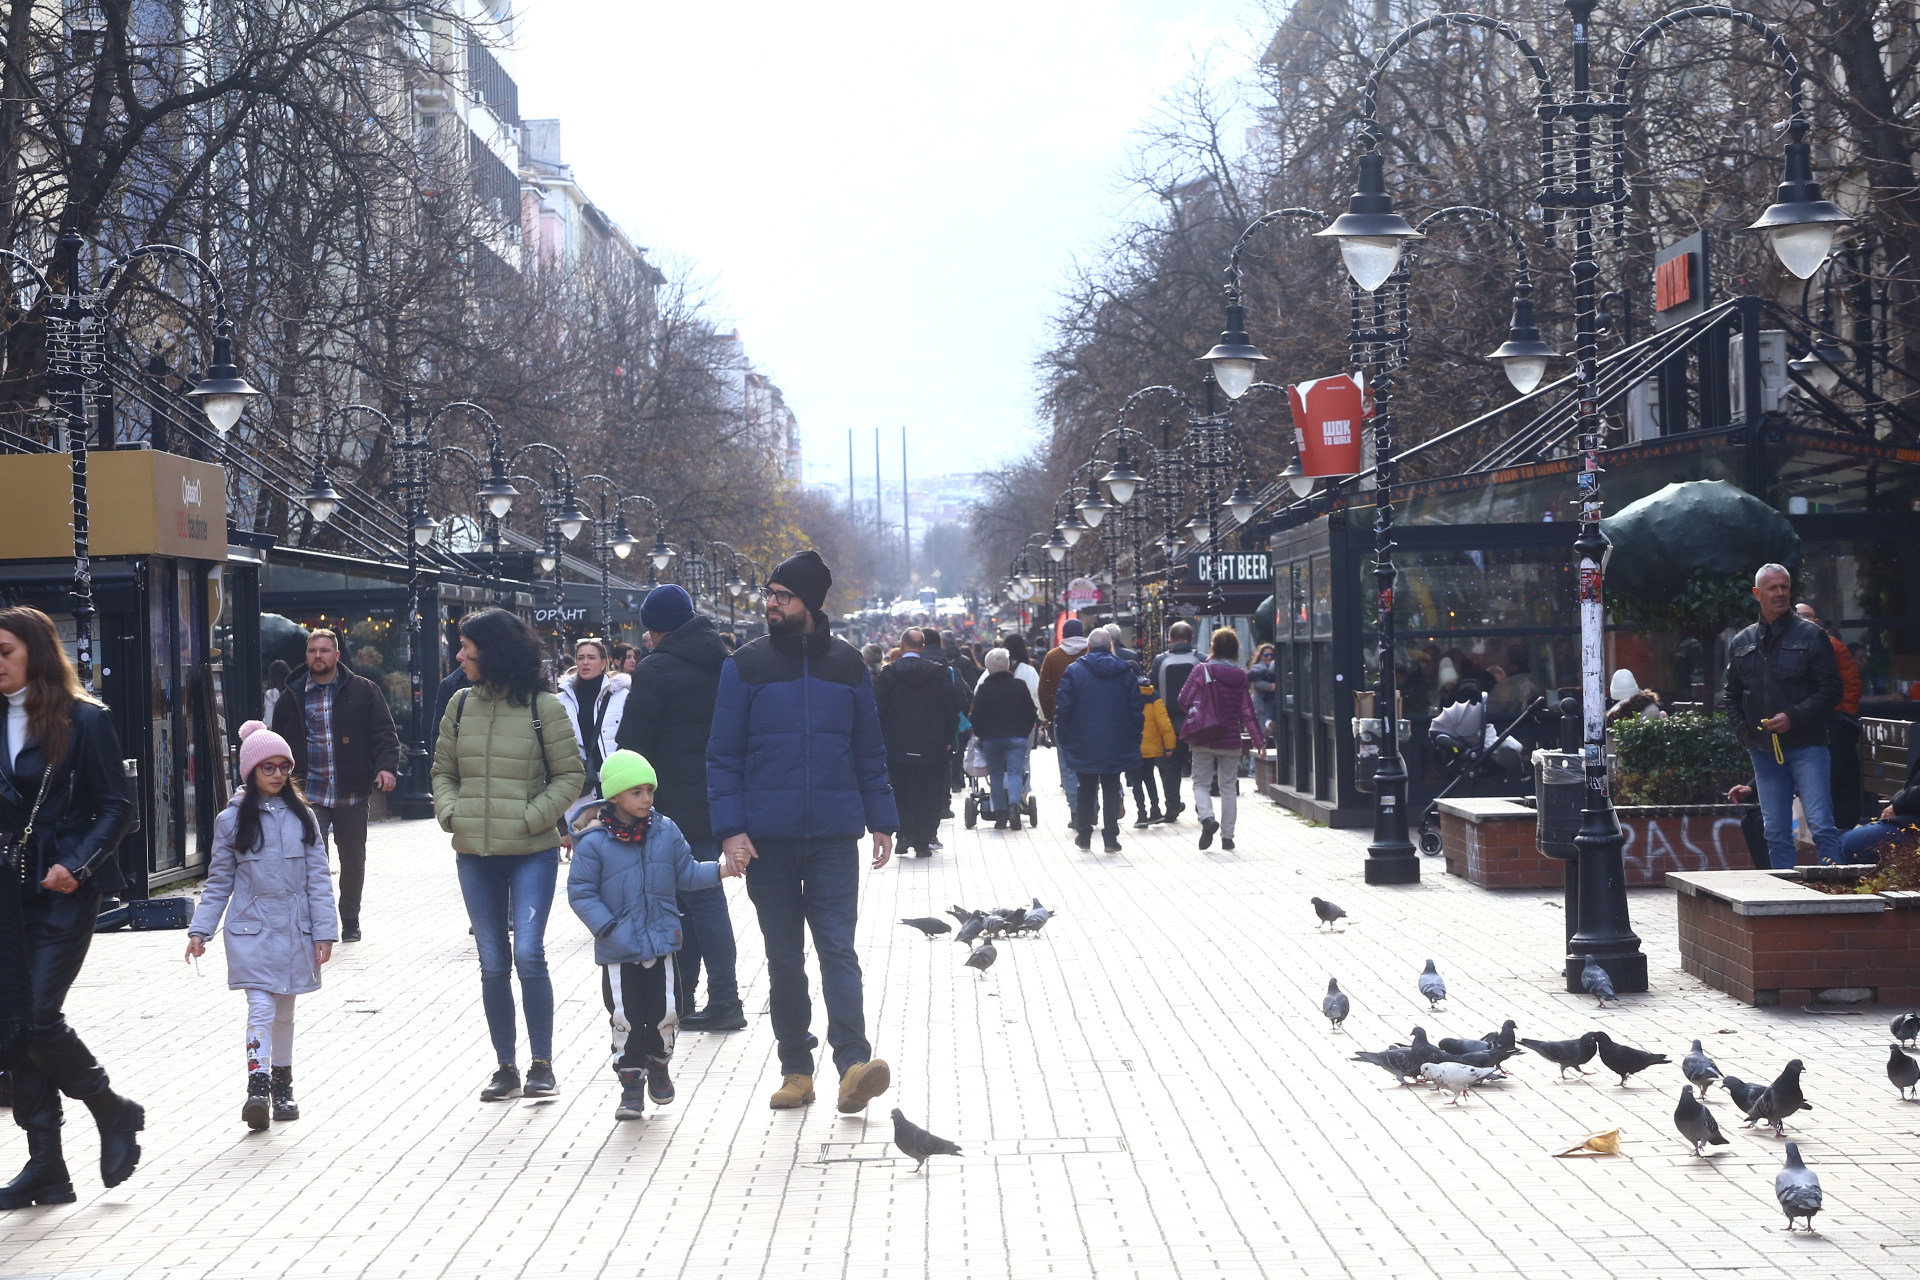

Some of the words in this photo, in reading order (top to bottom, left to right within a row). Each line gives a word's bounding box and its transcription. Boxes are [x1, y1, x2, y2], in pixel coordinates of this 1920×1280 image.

[1323, 420, 1351, 436] WOK
[1324, 436, 1332, 445] TO
[1333, 435, 1351, 444] WALK
[1238, 554, 1267, 579] BEER
